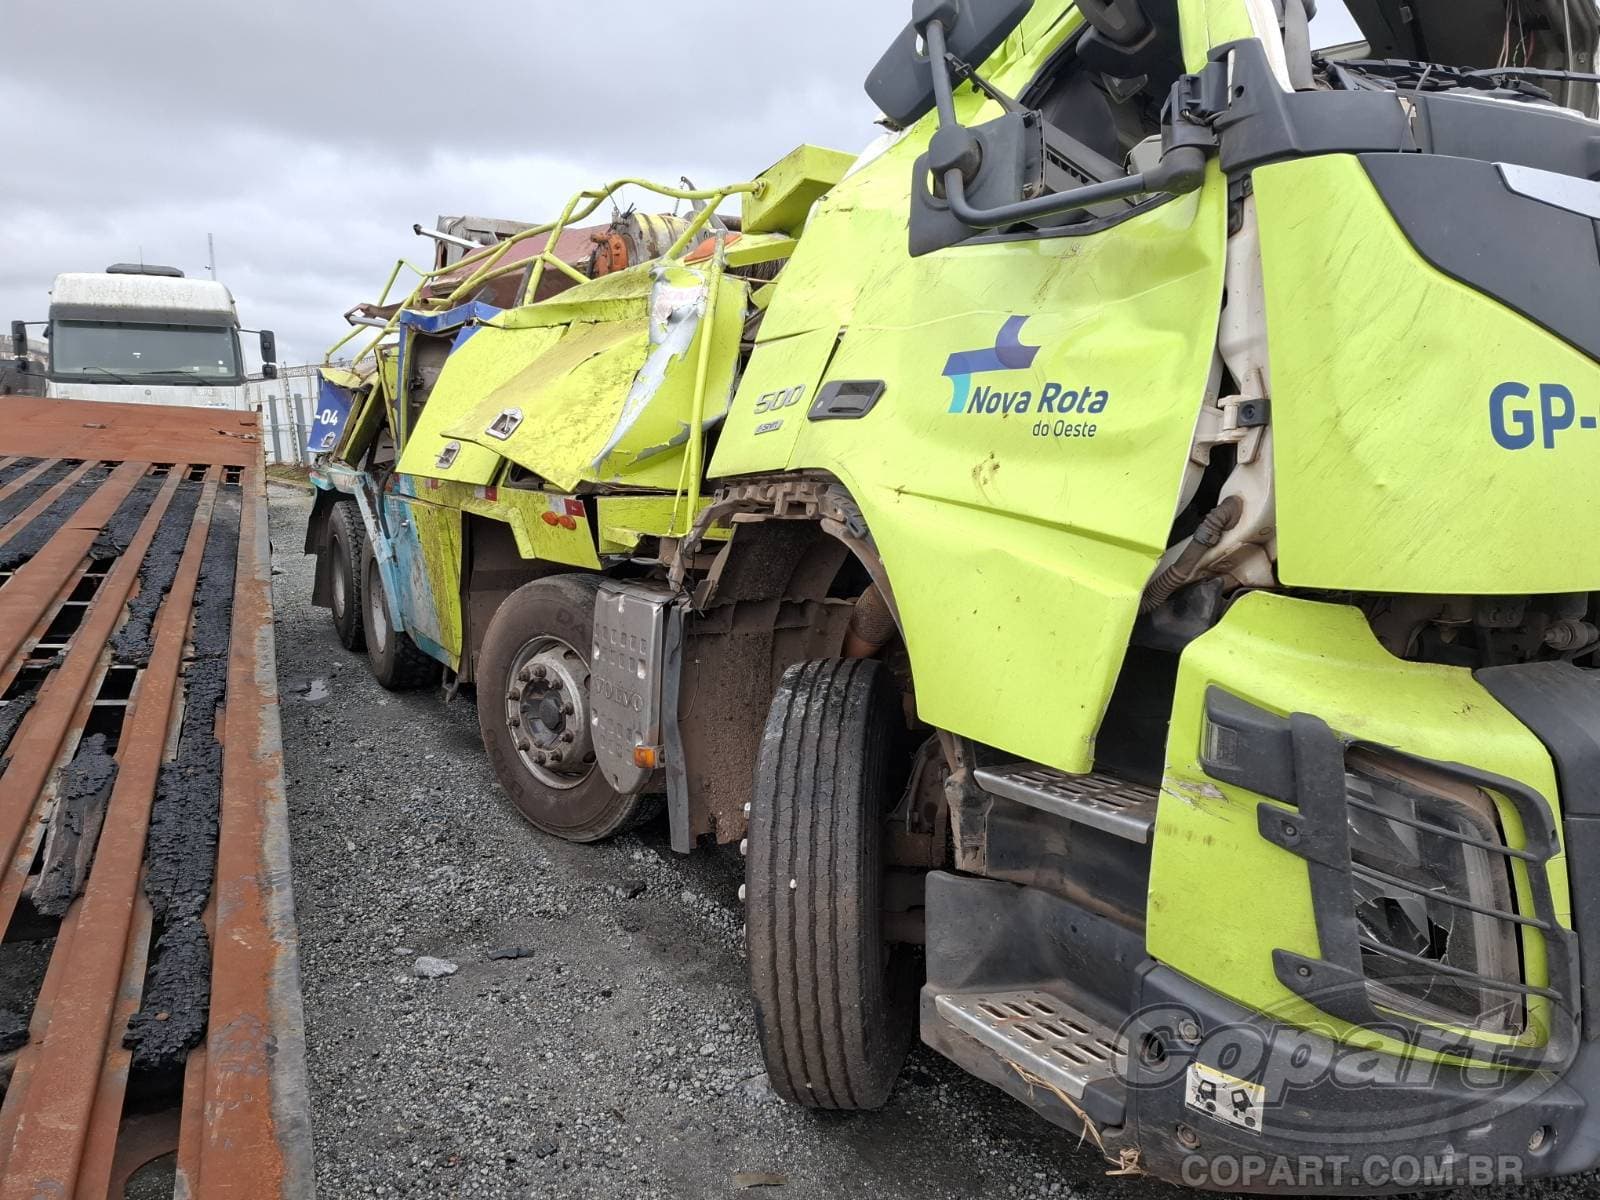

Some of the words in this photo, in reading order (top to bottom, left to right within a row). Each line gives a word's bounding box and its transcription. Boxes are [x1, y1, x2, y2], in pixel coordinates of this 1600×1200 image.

[753, 384, 806, 414] 500
[967, 386, 1032, 414] Nova
[1037, 382, 1109, 414] Rota
[1032, 420, 1049, 437] do
[1053, 420, 1097, 438] Oeste
